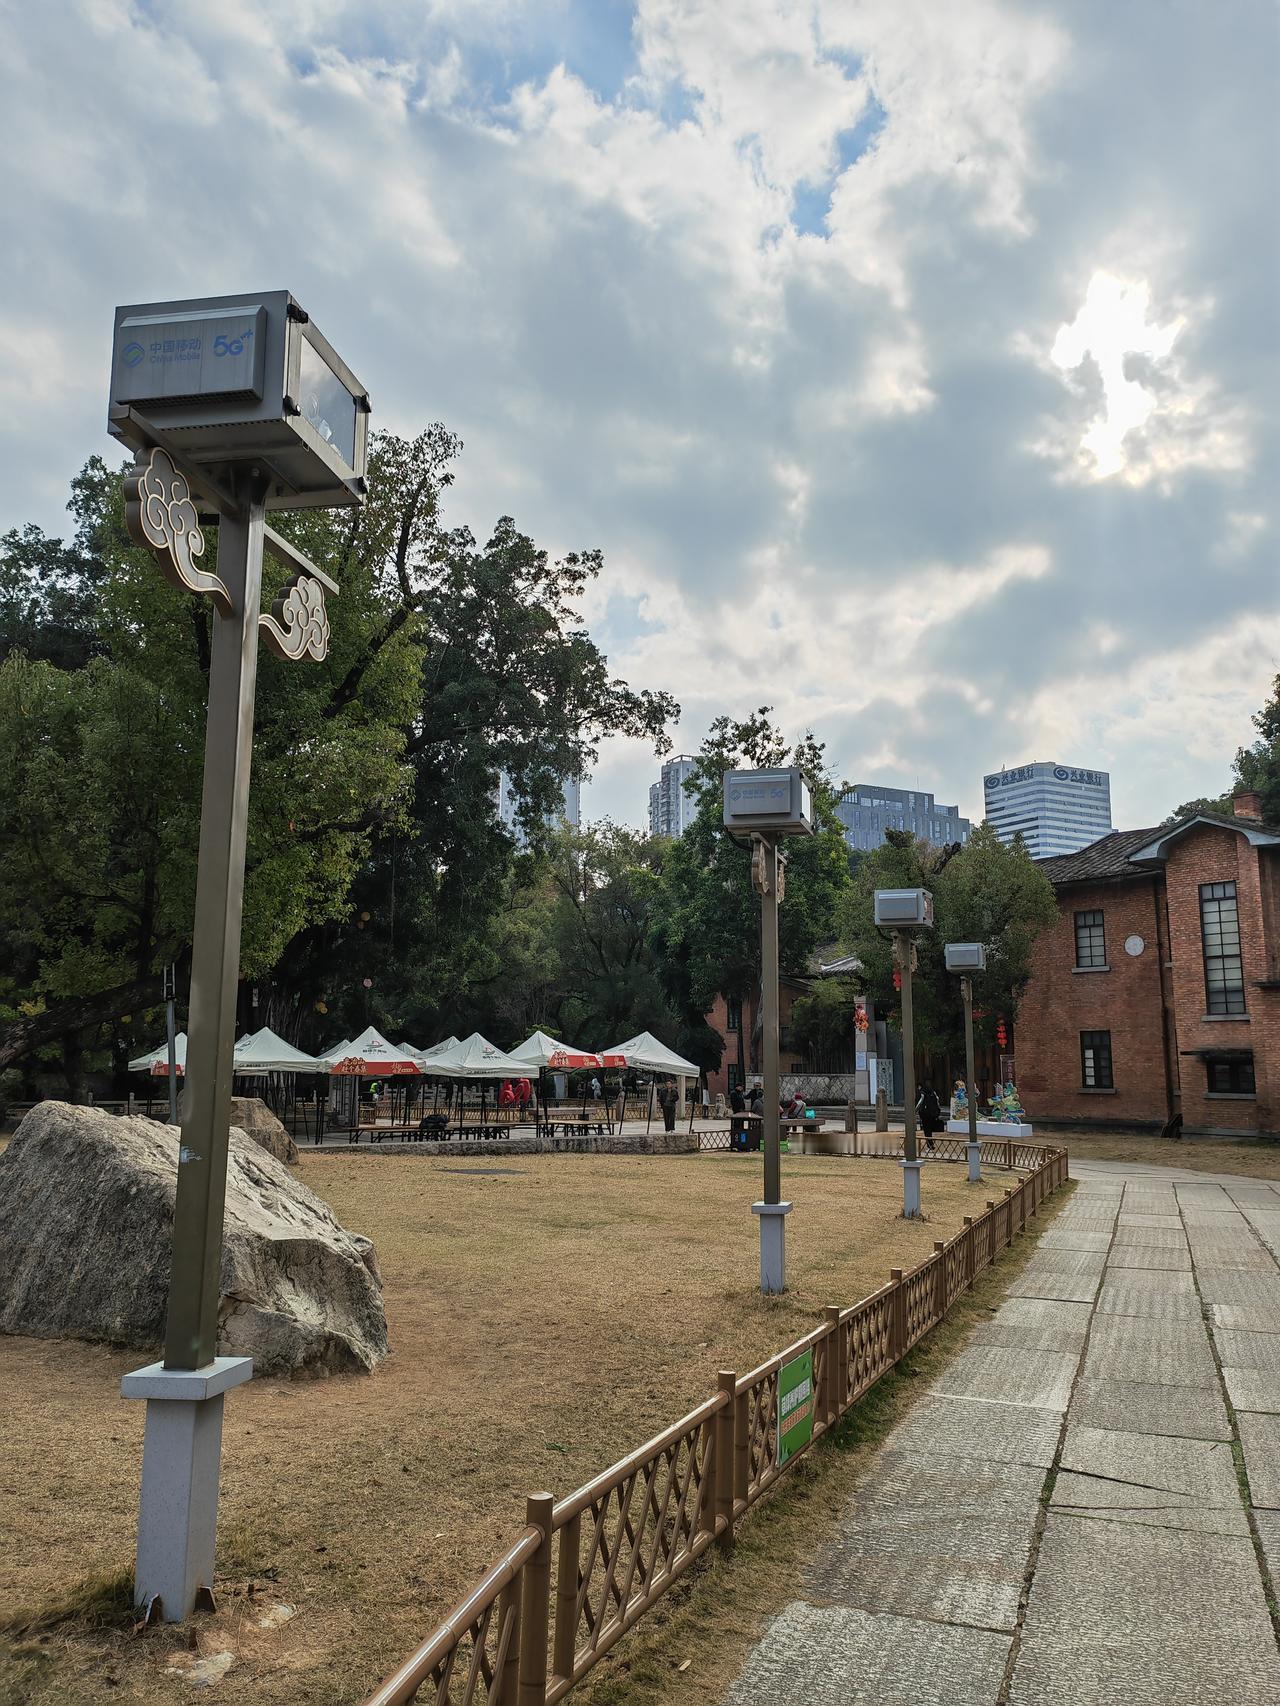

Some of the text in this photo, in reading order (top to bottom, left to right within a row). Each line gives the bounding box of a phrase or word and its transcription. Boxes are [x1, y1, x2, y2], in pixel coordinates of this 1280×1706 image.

[150, 338, 201, 354] 中国移动
[150, 352, 200, 364] China Mobile
[1002, 766, 1034, 782] 兴业银行
[1070, 769, 1101, 785] 兴业银行
